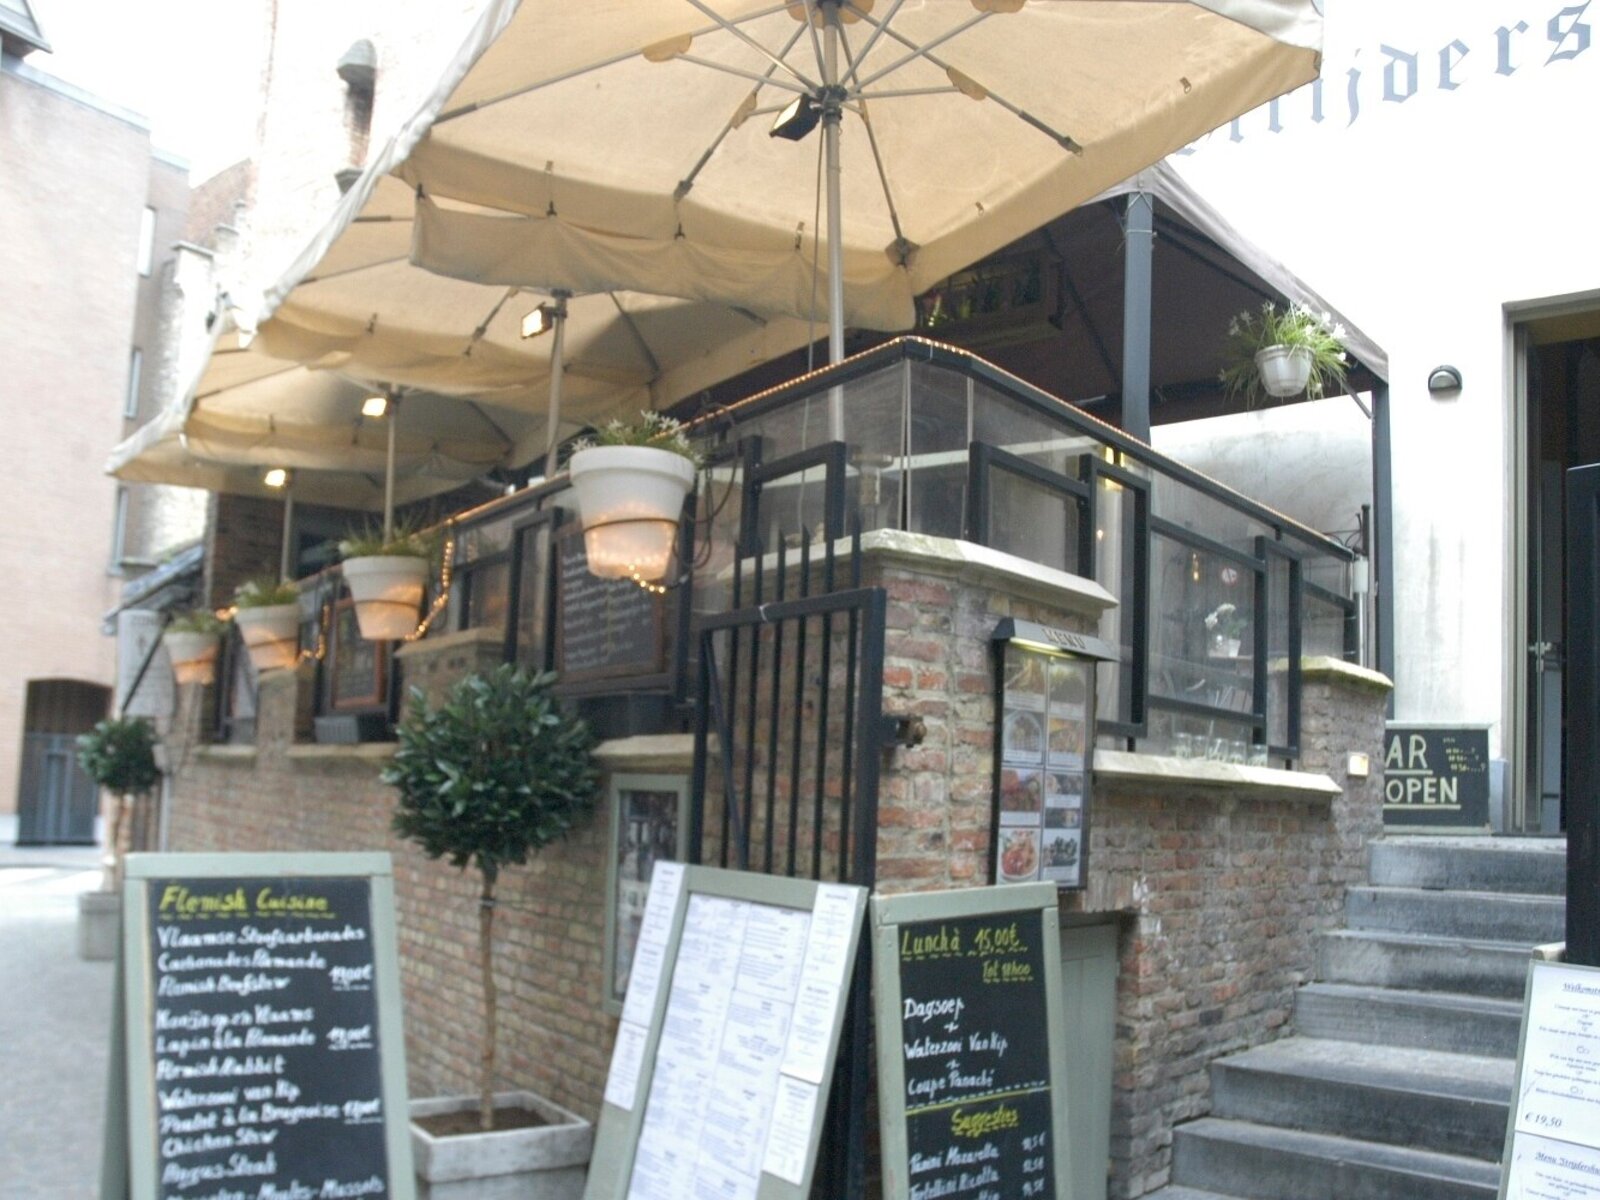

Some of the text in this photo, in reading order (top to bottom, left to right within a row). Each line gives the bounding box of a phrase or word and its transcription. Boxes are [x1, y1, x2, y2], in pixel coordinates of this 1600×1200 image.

[1041, 627, 1086, 649] MENU
[1385, 734, 1428, 769] AR
[1386, 776, 1458, 804] OPEN
[159, 886, 329, 913] Flemish Cuisine
[902, 925, 947, 955] Lunch
[904, 997, 965, 1024] Dagsoep
